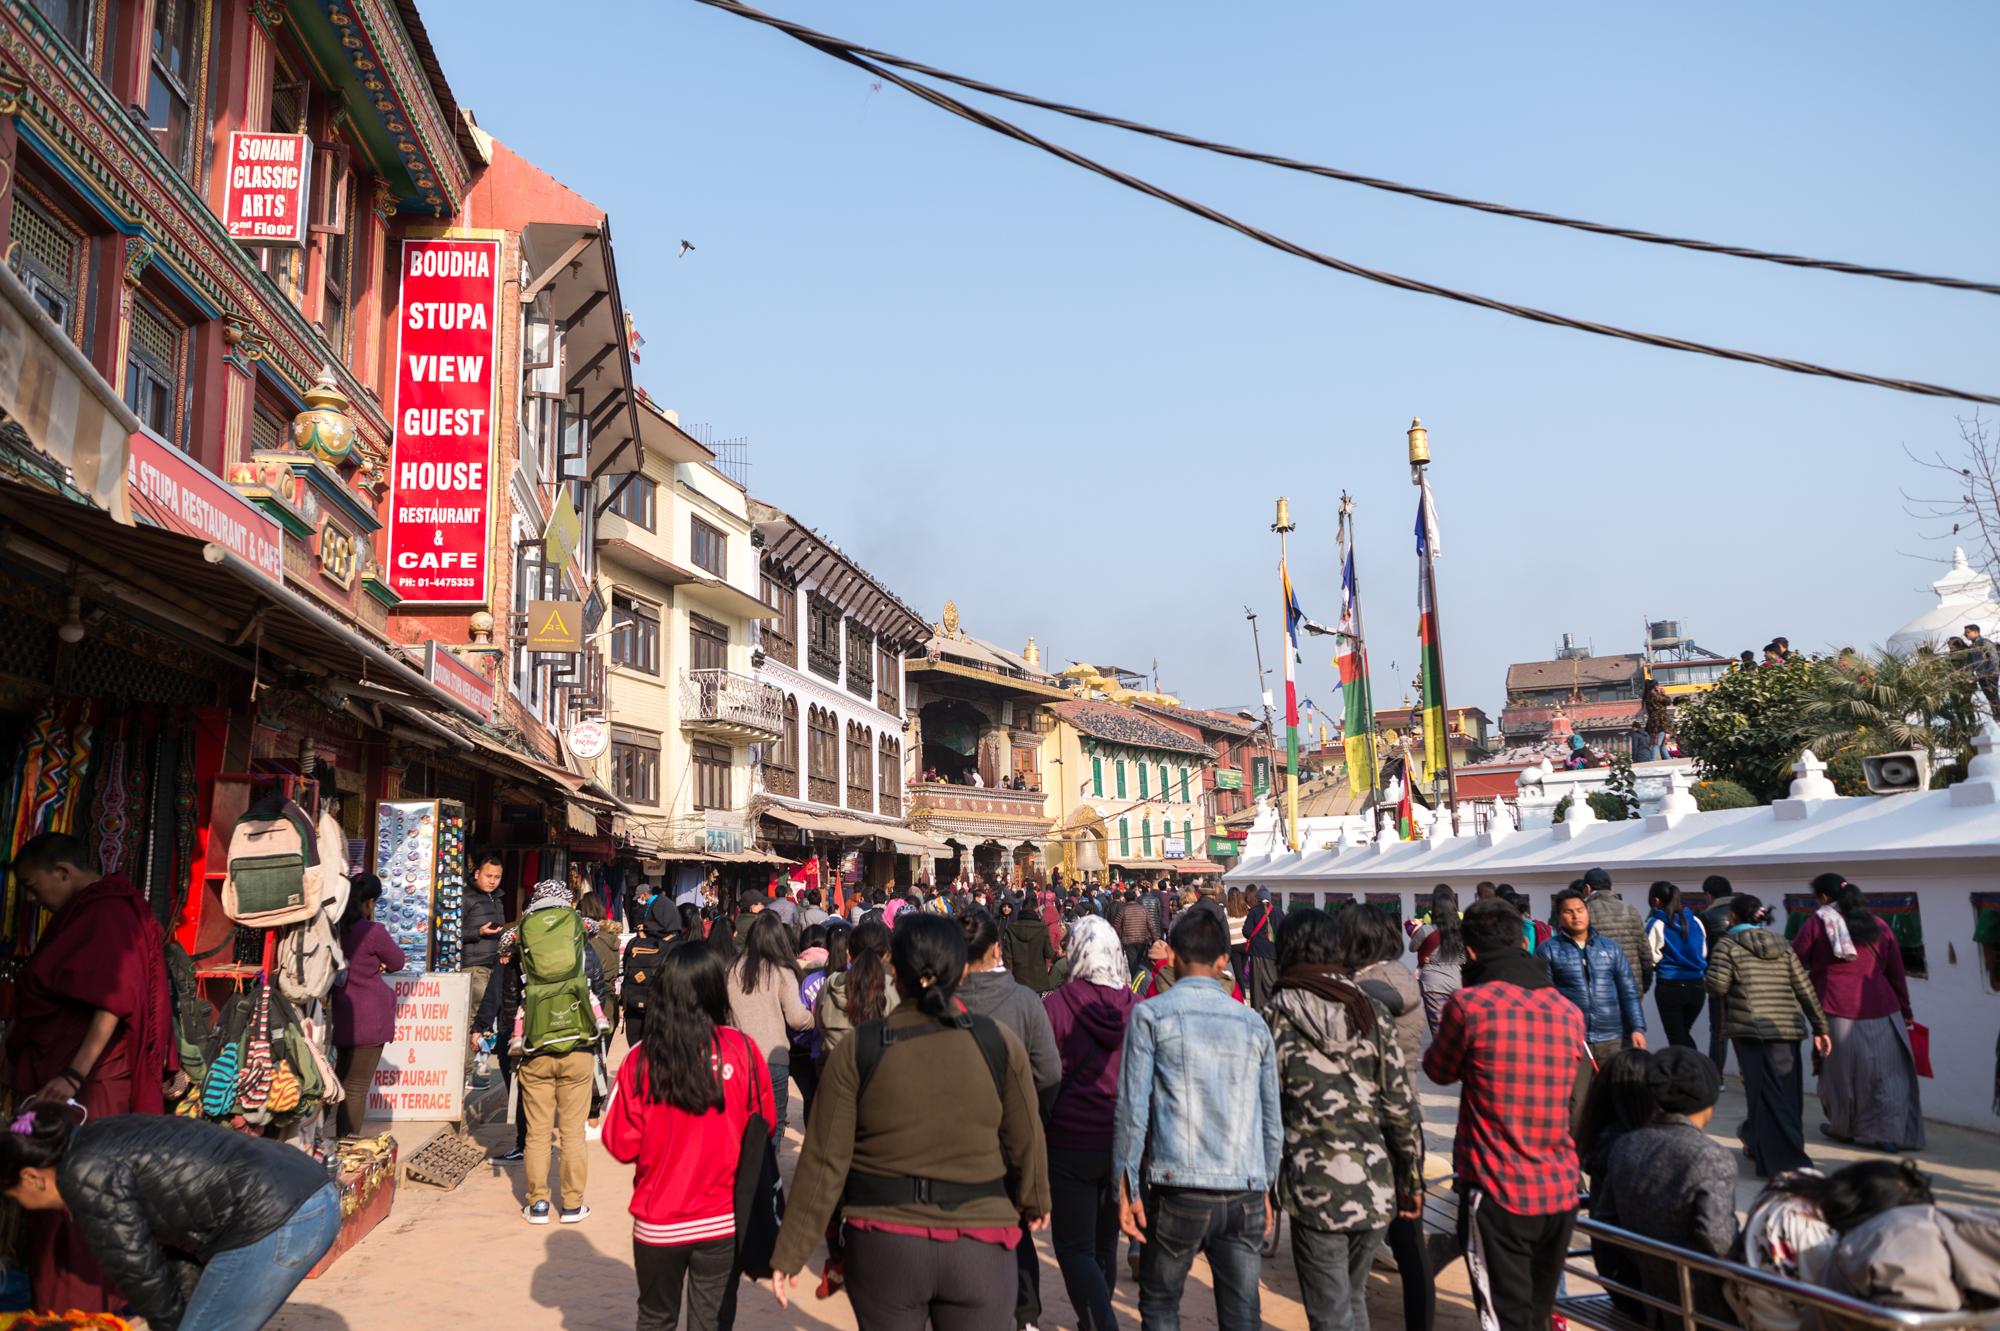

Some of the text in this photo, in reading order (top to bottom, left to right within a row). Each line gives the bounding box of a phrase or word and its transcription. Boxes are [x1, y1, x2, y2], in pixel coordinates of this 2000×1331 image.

[239, 138, 295, 161] SONAM
[233, 165, 298, 189] CLASSIC
[241, 194, 286, 217] ARTS
[229, 221, 293, 235] 2nd Floor
[410, 250, 489, 277] BOUDHA
[408, 302, 487, 330] STUPA
[409, 355, 484, 382] VIEW
[404, 408, 485, 436] GUEST
[400, 462, 482, 490] HOUSE
[140, 460, 179, 515] STUPA
[181, 487, 247, 556] RESTAURANT
[249, 531, 256, 561] &
[257, 537, 281, 576] CAFE
[399, 507, 480, 524] RESTAURANT
[433, 530, 444, 546] &
[397, 552, 477, 569] CAFE
[399, 578, 474, 587] PH: 01-4475333
[395, 981, 440, 998] BOUDHA
[395, 1003, 449, 1020] UPA VIEW
[393, 1026, 453, 1041] EST HOUSE
[408, 1048, 416, 1064] &
[374, 1070, 448, 1087] RESTAURANT
[369, 1093, 451, 1110] WITH TERRACE
